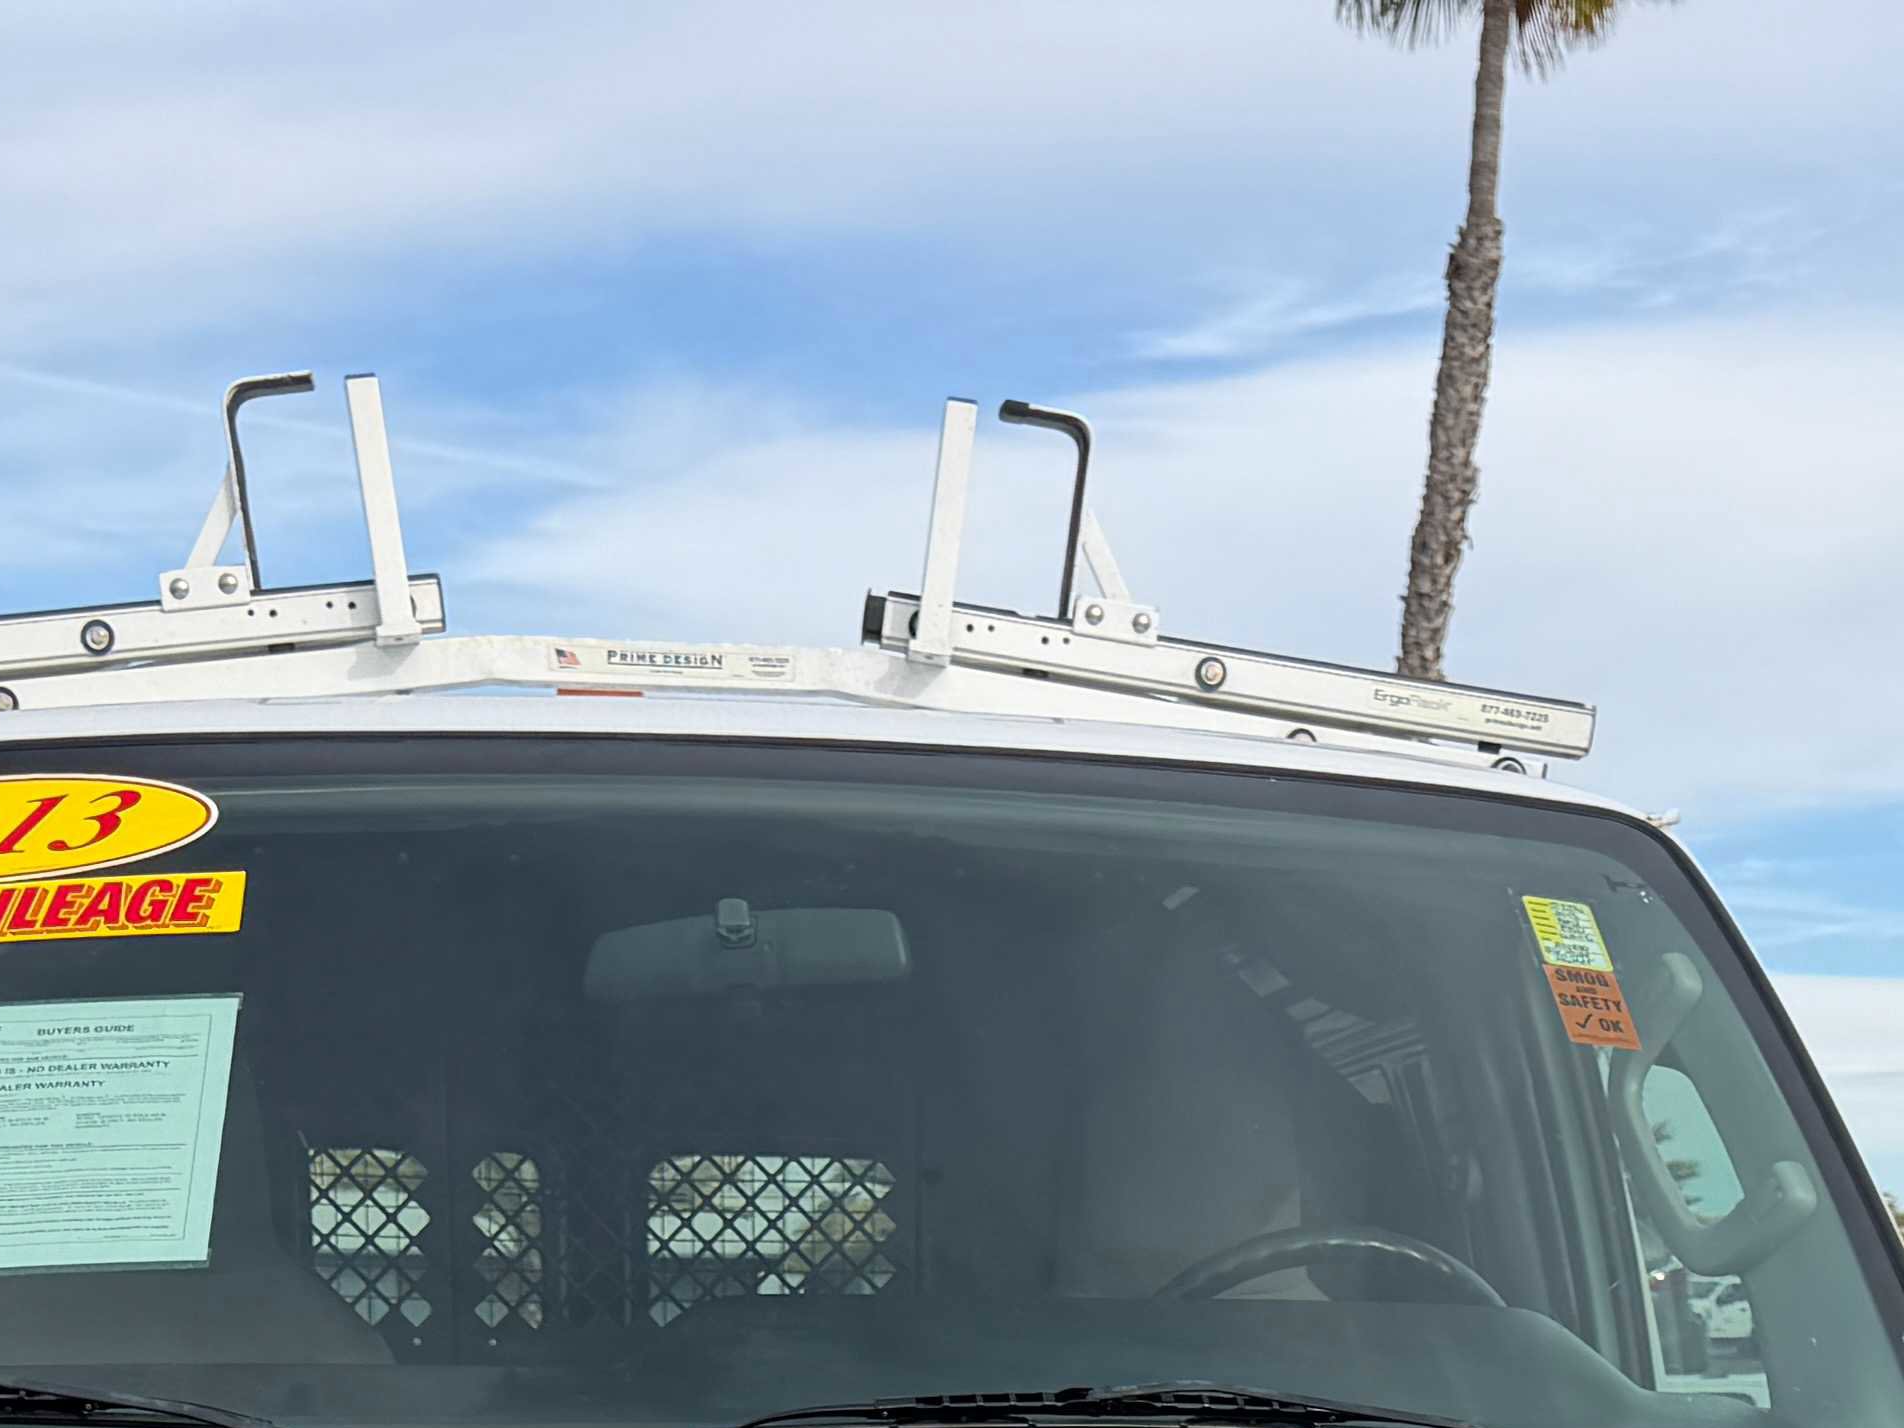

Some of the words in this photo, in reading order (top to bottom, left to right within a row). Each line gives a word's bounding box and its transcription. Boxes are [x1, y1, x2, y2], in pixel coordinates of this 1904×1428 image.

[607, 650, 657, 664] PRIME
[663, 652, 723, 667] DESIGN
[1554, 968, 1610, 988] SMOG
[1557, 992, 1624, 1013] SAFETY
[36, 1024, 91, 1036] BUYERS
[94, 1024, 136, 1034] GUIDE
[1598, 1017, 1624, 1034] OK
[3, 1066, 17, 1075] IS
[26, 1064, 45, 1073] NO
[46, 1062, 97, 1073] DEALER
[100, 1060, 171, 1071] WARRANTY
[34, 1080, 106, 1090] WARRANTY
